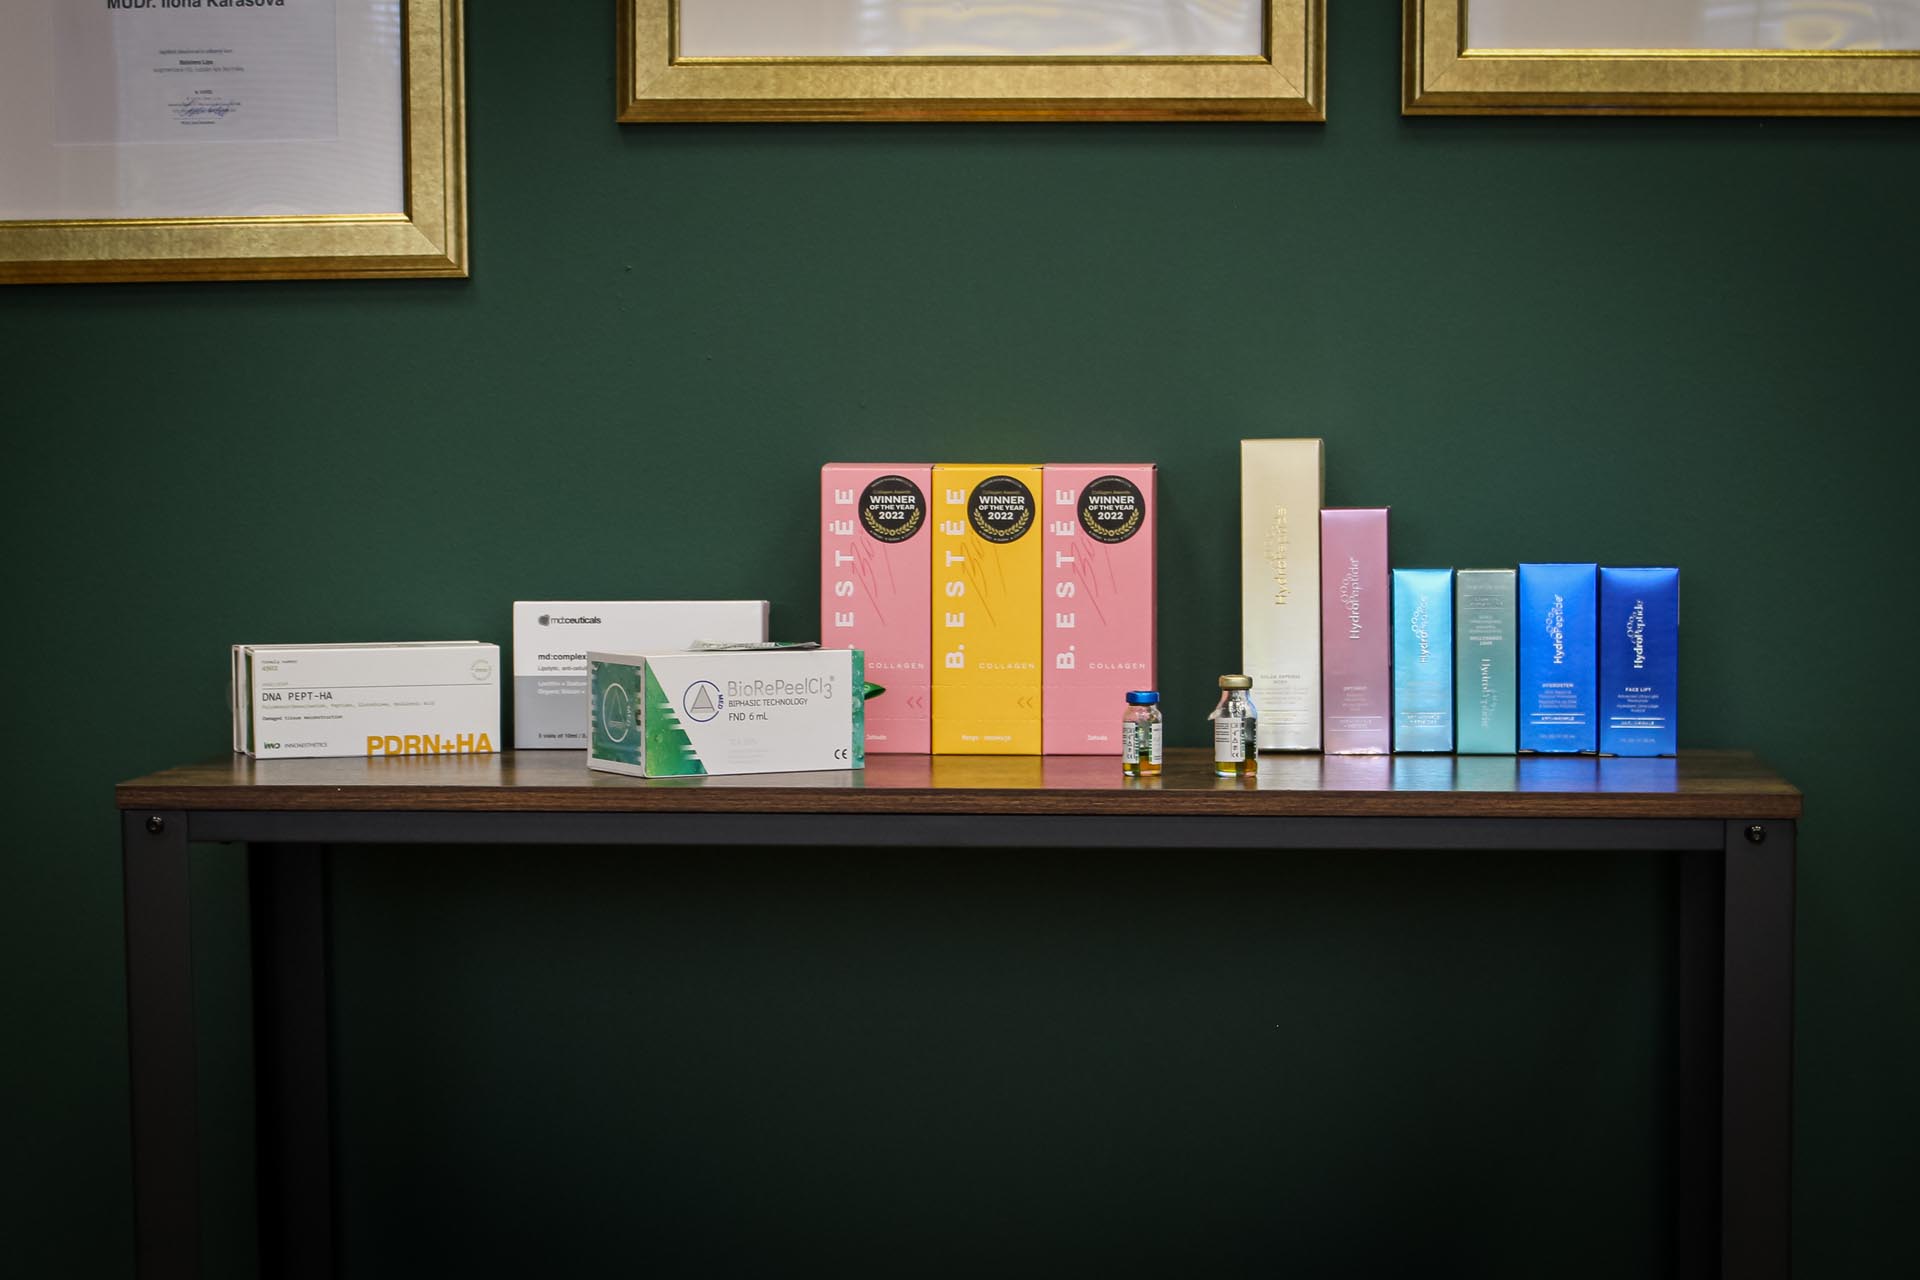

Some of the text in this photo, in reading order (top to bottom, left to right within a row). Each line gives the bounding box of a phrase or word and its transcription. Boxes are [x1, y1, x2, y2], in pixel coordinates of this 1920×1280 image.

[107, 0, 157, 9] MUDr.
[162, 0, 201, 8] Ilona
[870, 495, 916, 504] WINNER
[979, 496, 1025, 504] WINNER
[1088, 496, 1135, 504] WINNER
[878, 511, 905, 520] 2022
[987, 512, 1014, 520] 2022
[1097, 512, 1124, 520] 2022
[1348, 559, 1363, 640] HydroPeptide
[1552, 594, 1565, 664] HydroPeptide
[1633, 599, 1646, 669] HydroPeptide
[945, 644, 965, 669] B.
[1056, 644, 1075, 669] B.
[868, 662, 924, 670] COLLAGEN
[262, 691, 333, 702] DNA PEPT-HA
[728, 698, 808, 707] BIPHASIC TECHNOLOGY
[729, 712, 768, 721] FND 6 mL
[367, 733, 493, 757] PDRN+HA
